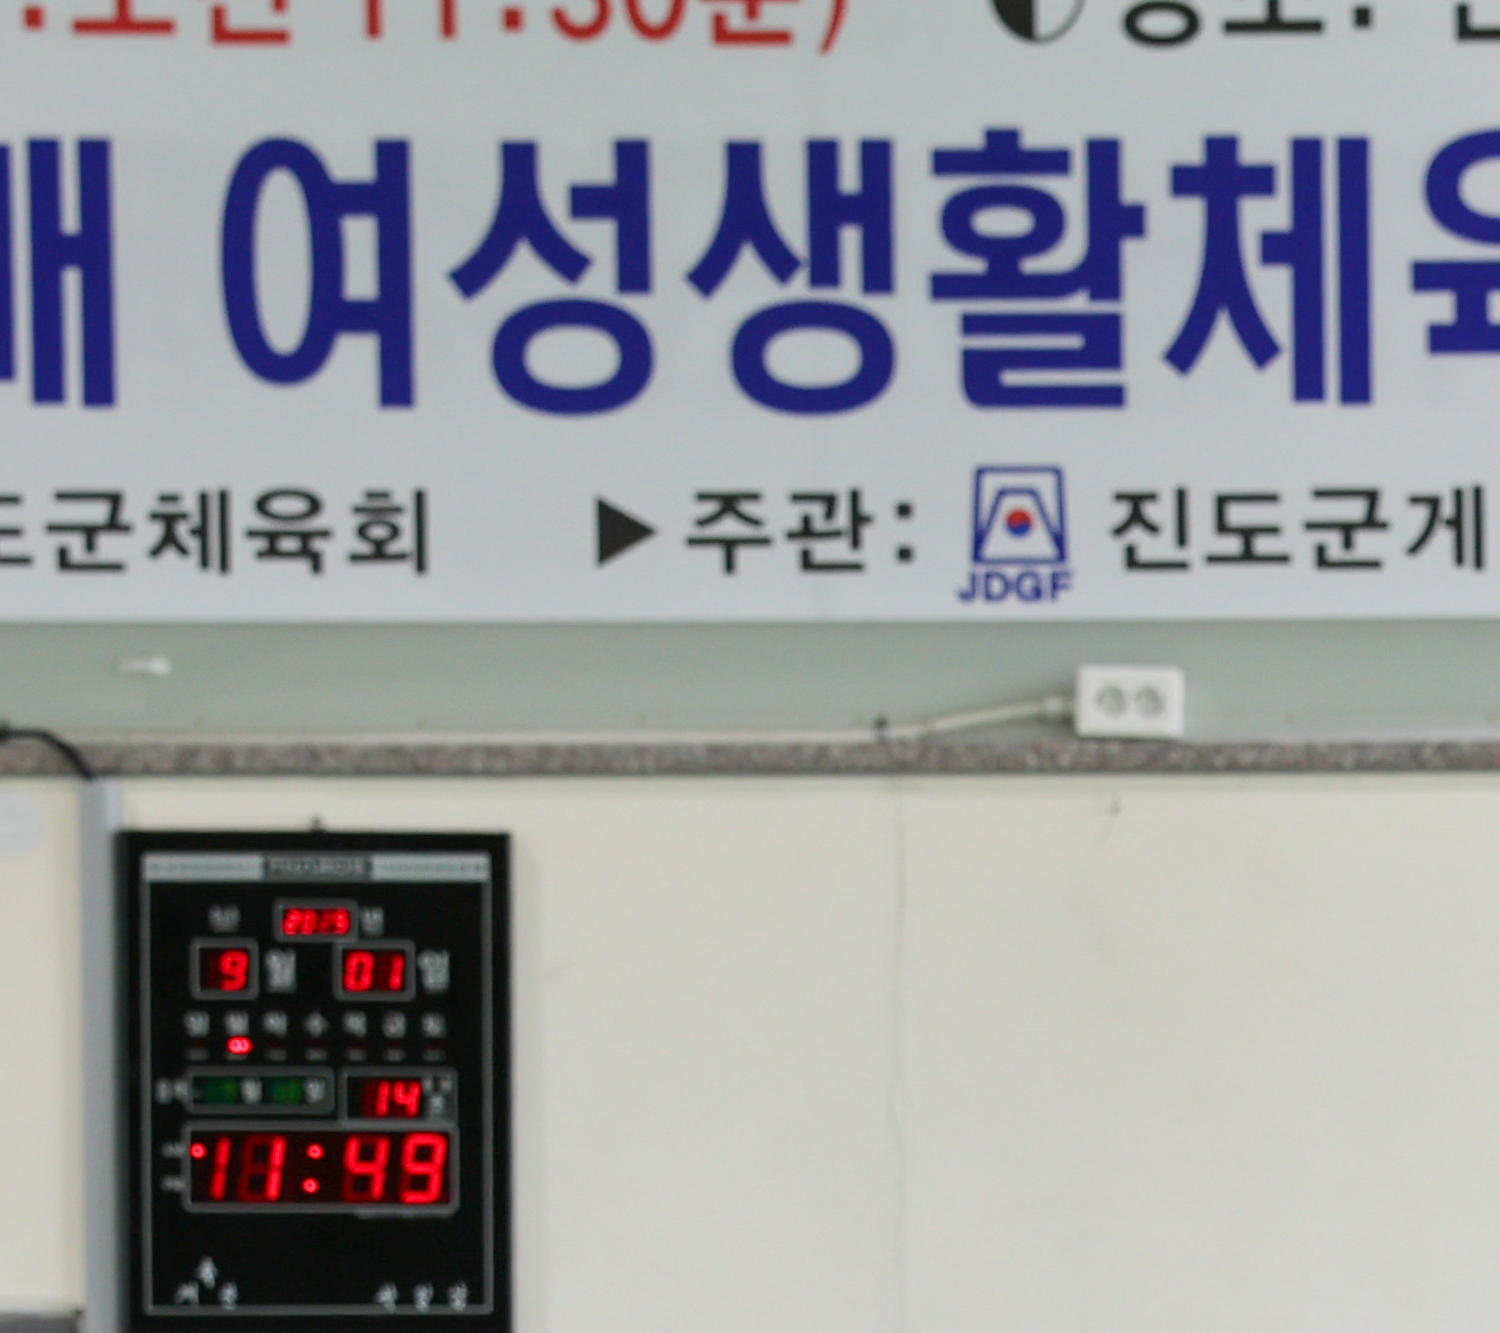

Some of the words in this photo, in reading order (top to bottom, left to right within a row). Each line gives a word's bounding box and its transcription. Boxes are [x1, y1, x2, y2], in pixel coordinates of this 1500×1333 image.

[683, 486, 916, 577] 주관:
[957, 569, 1075, 602] JDGF
[219, 950, 250, 991] 9
[343, 951, 406, 992] 01
[208, 1131, 449, 1204] 11:49
